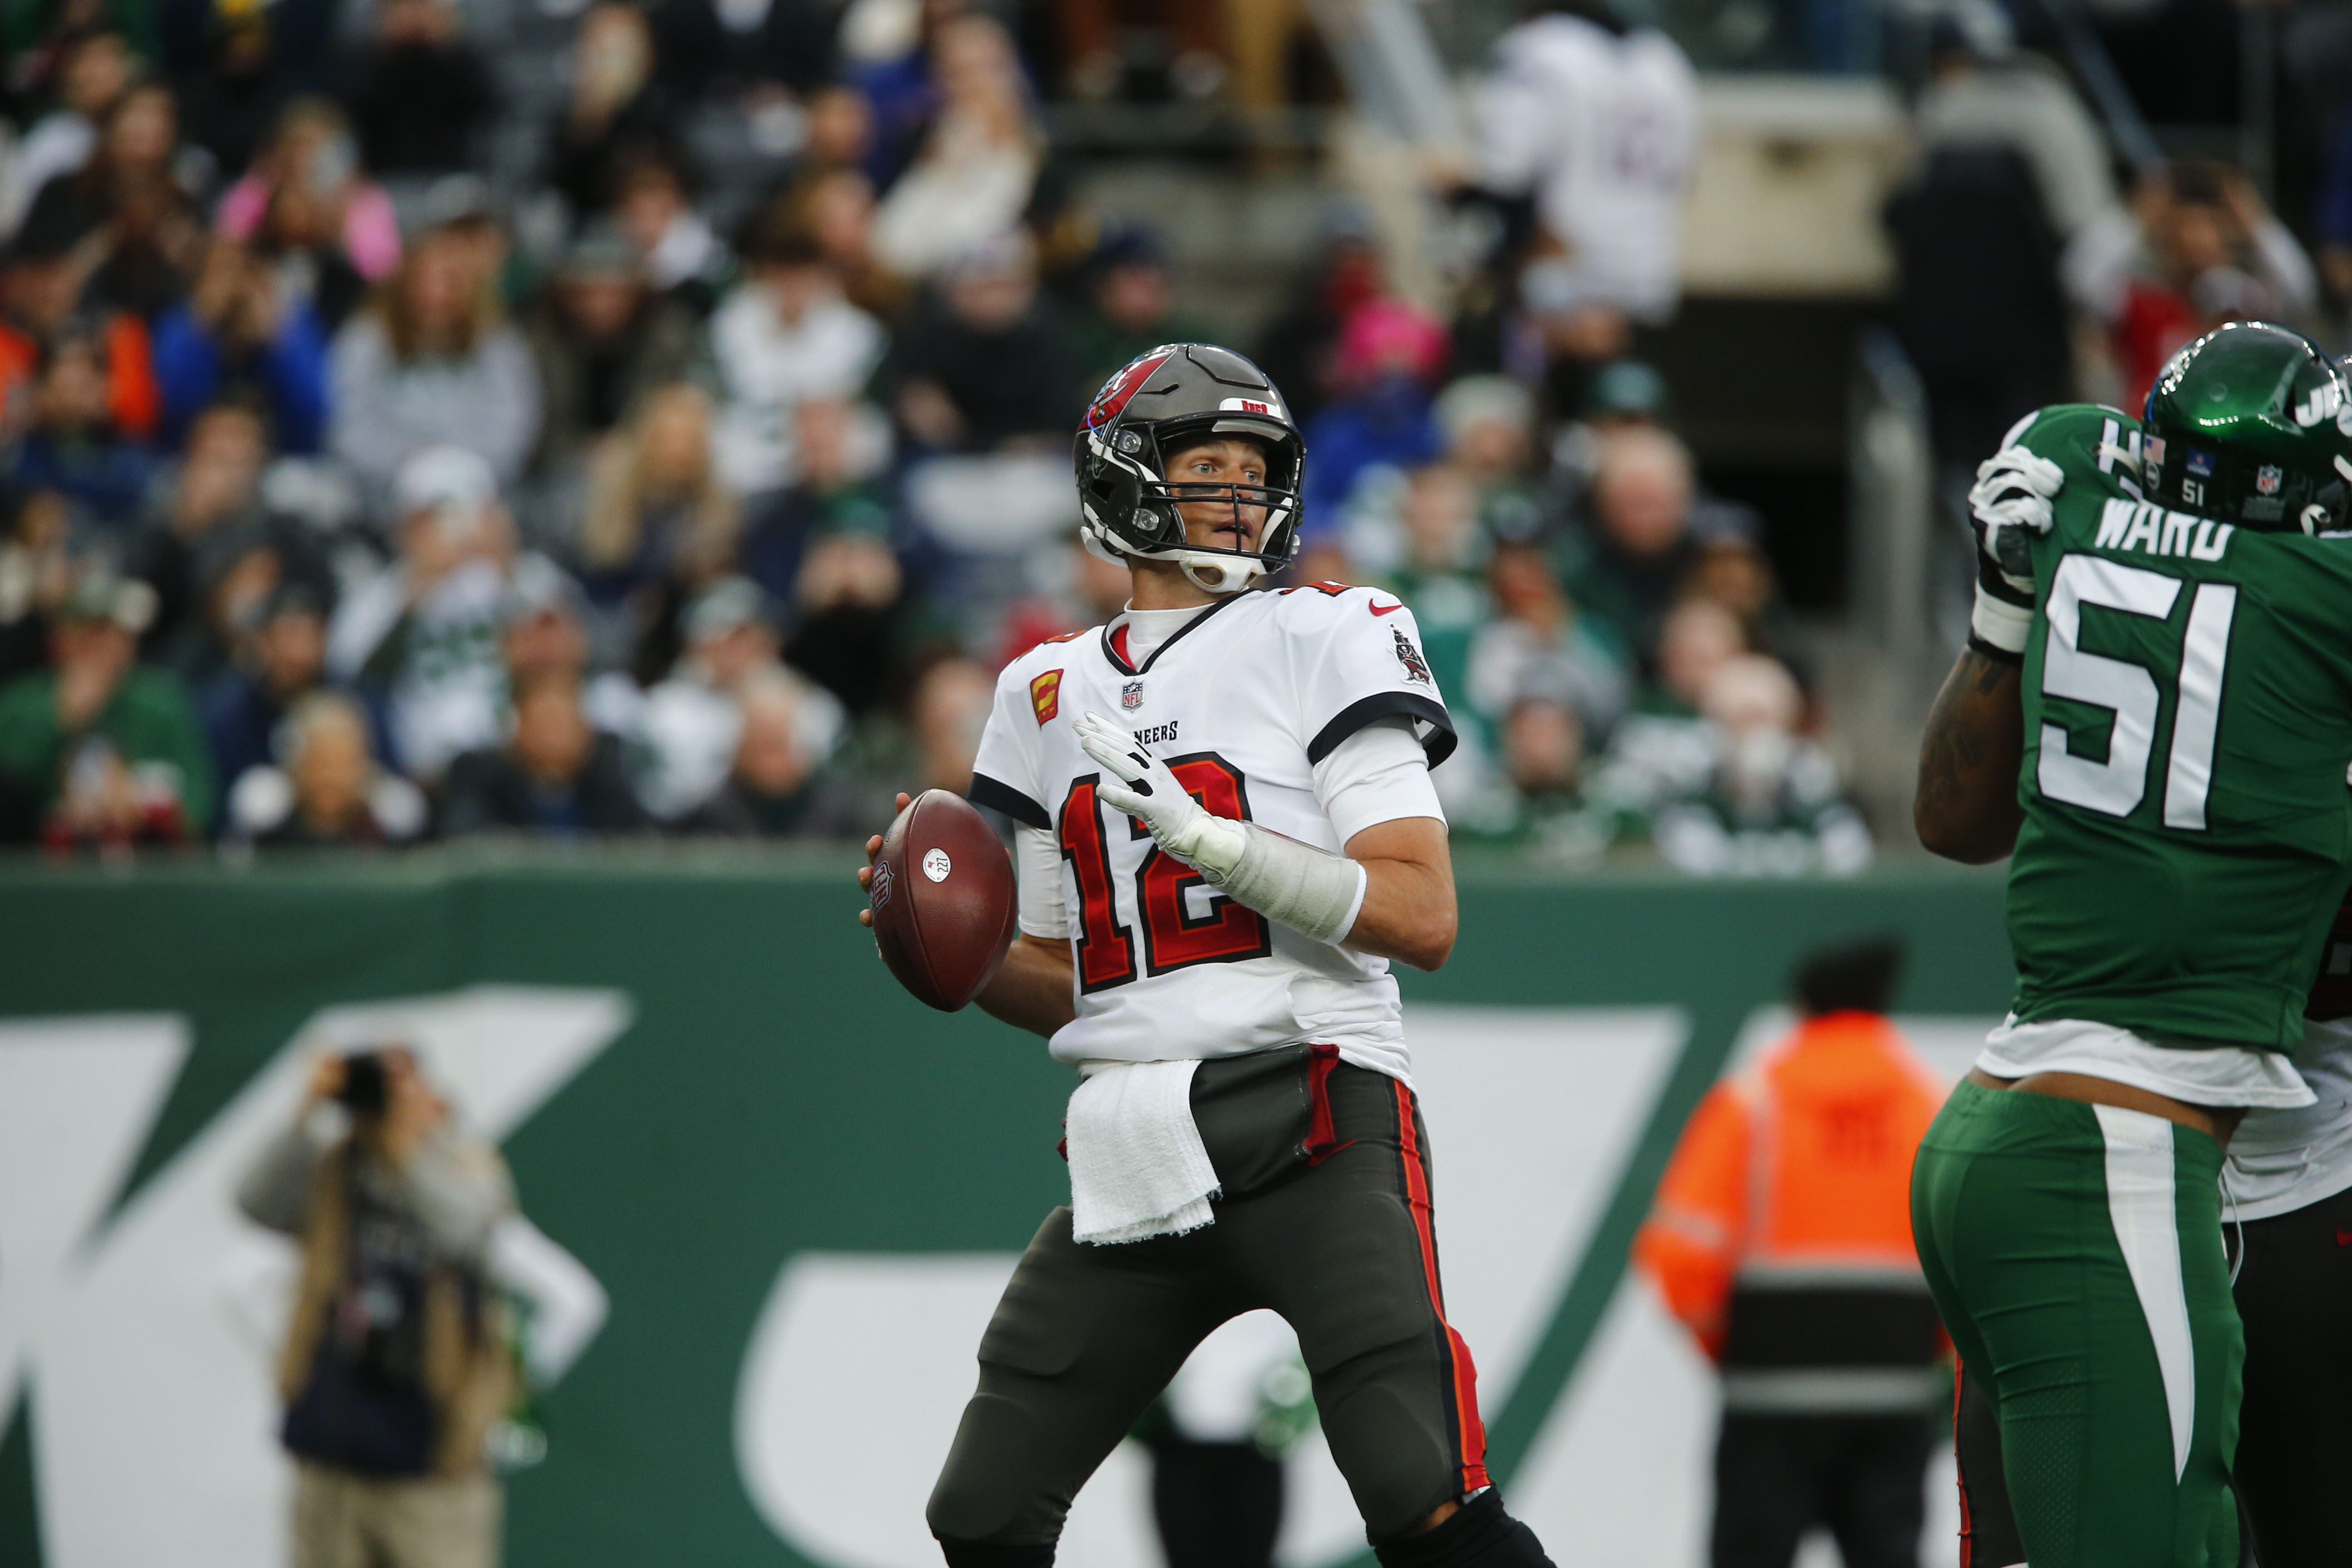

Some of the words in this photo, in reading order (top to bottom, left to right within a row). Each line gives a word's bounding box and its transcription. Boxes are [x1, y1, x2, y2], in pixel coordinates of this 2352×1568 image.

[2182, 478, 2204, 507] 51
[2094, 497, 2235, 562] WARD
[1032, 673, 1058, 712] C
[1124, 692, 1141, 706] NFL
[2037, 553, 2238, 831] 51
[1133, 720, 1178, 745] NEERS
[936, 857, 949, 872] 227
[1059, 751, 1272, 995] 12
